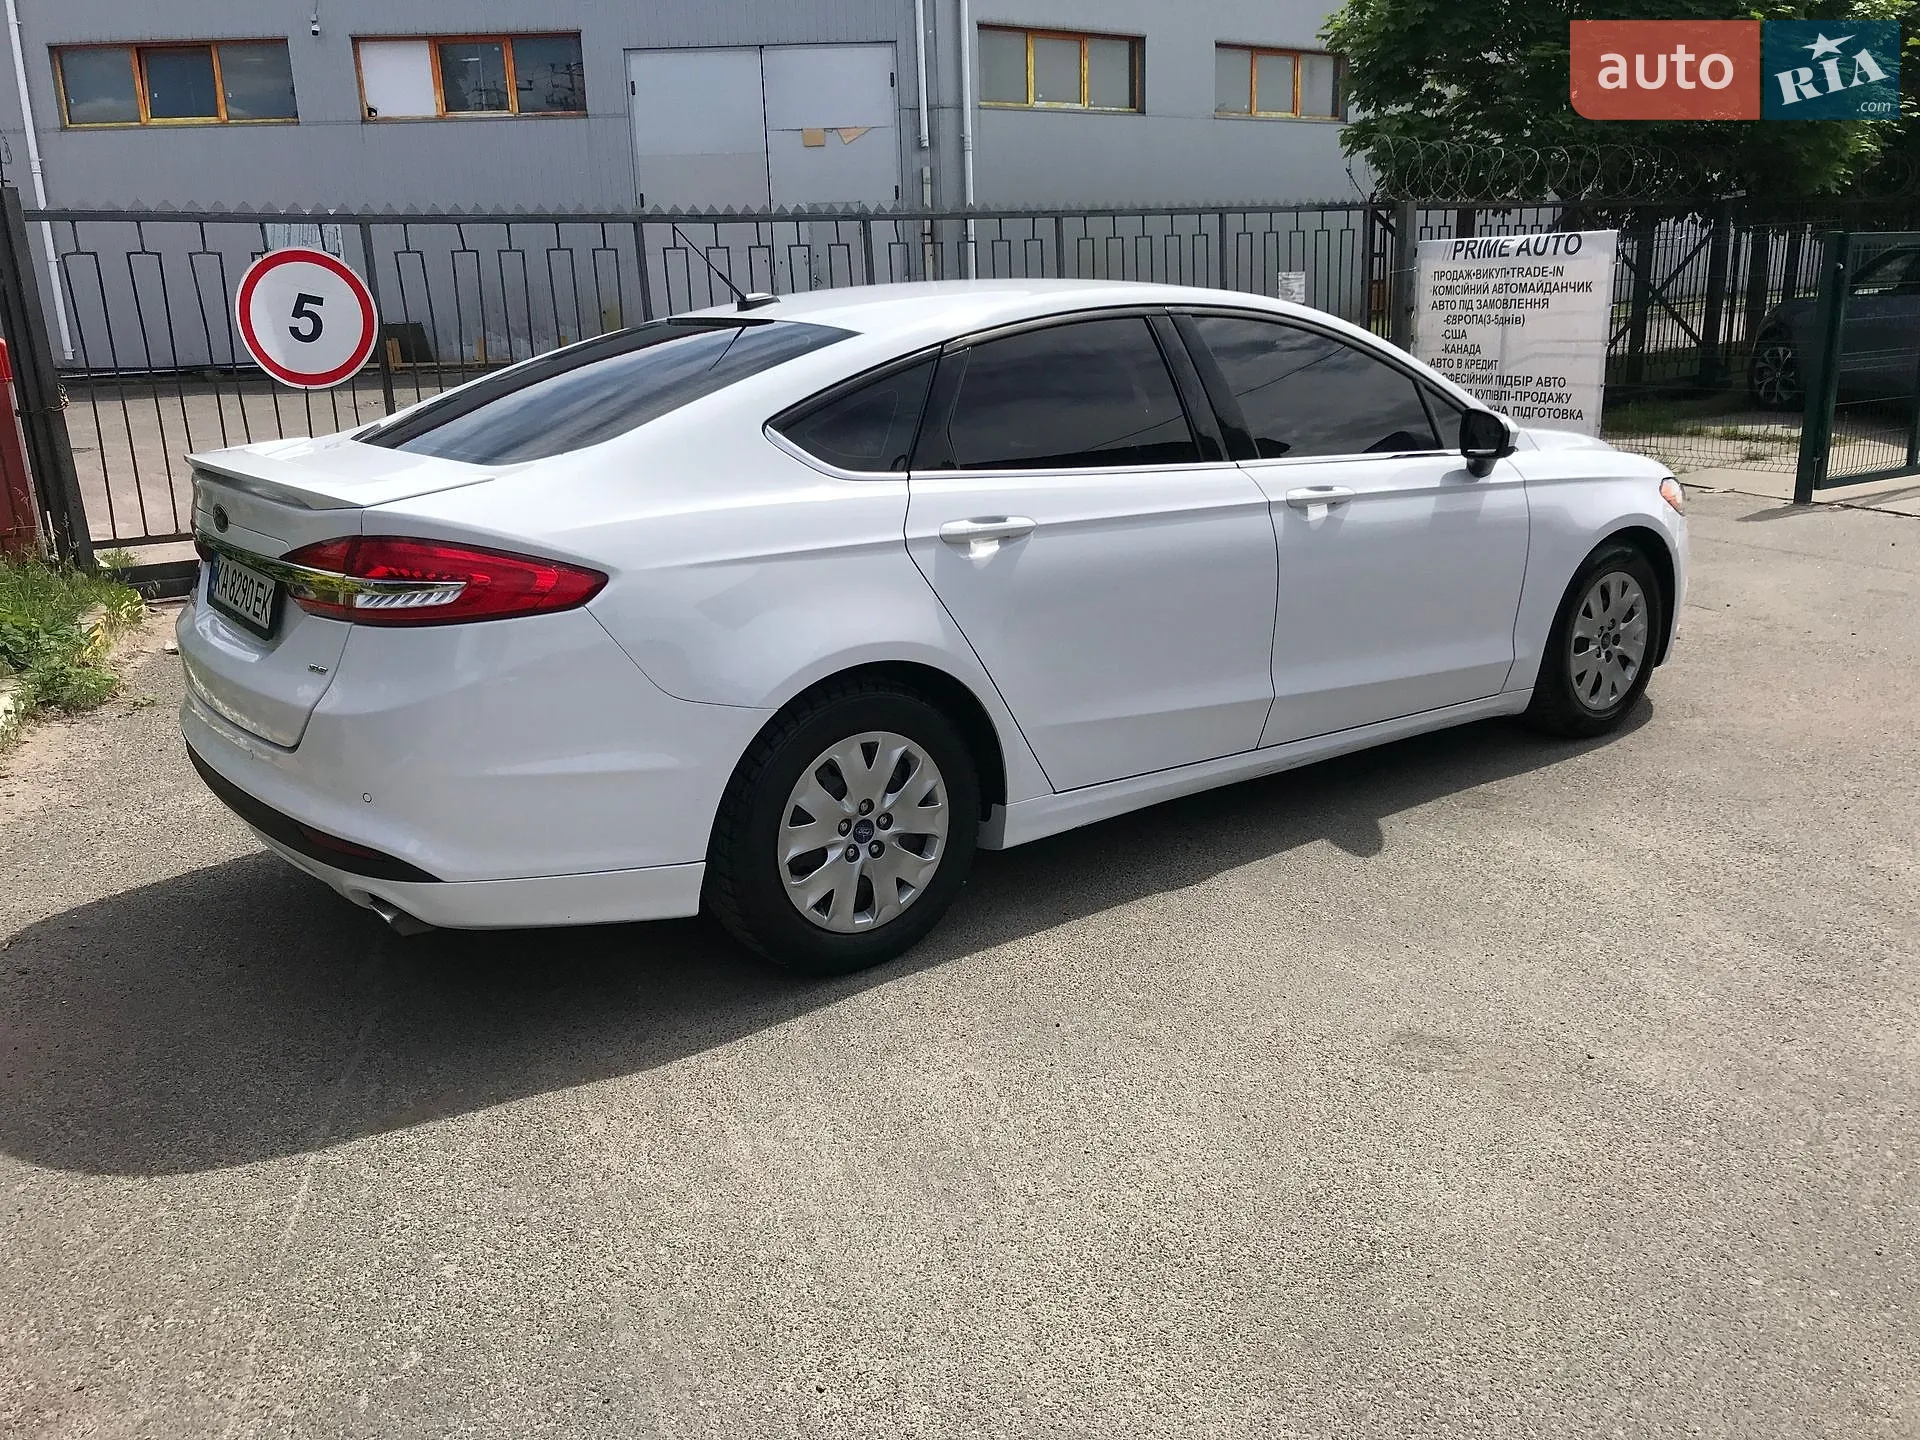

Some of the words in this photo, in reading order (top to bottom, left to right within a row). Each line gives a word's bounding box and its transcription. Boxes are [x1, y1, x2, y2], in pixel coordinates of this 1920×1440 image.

[1452, 239, 1514, 260] PRIME
[1515, 233, 1582, 257] AUTO
[1432, 282, 1489, 296] КОМІСІЙНИЙ
[1492, 280, 1592, 295] АВТОМАЙДАНЧИК
[1431, 299, 1456, 310] АВТО
[1459, 299, 1474, 312] ПІД
[1477, 298, 1549, 310] ЗАМОВЛЕННЯ
[288, 292, 325, 343] 5
[1430, 358, 1454, 368] АВТО
[1457, 359, 1463, 369] В
[1465, 359, 1498, 371] КРЕДИТ
[1495, 376, 1532, 388] ПІДБІР
[1536, 377, 1566, 388] АВТО
[1512, 406, 1583, 420] ПІДГОТОВКА
[214, 559, 229, 599] KA
[229, 568, 254, 612] 8290
[252, 581, 274, 625] EK
